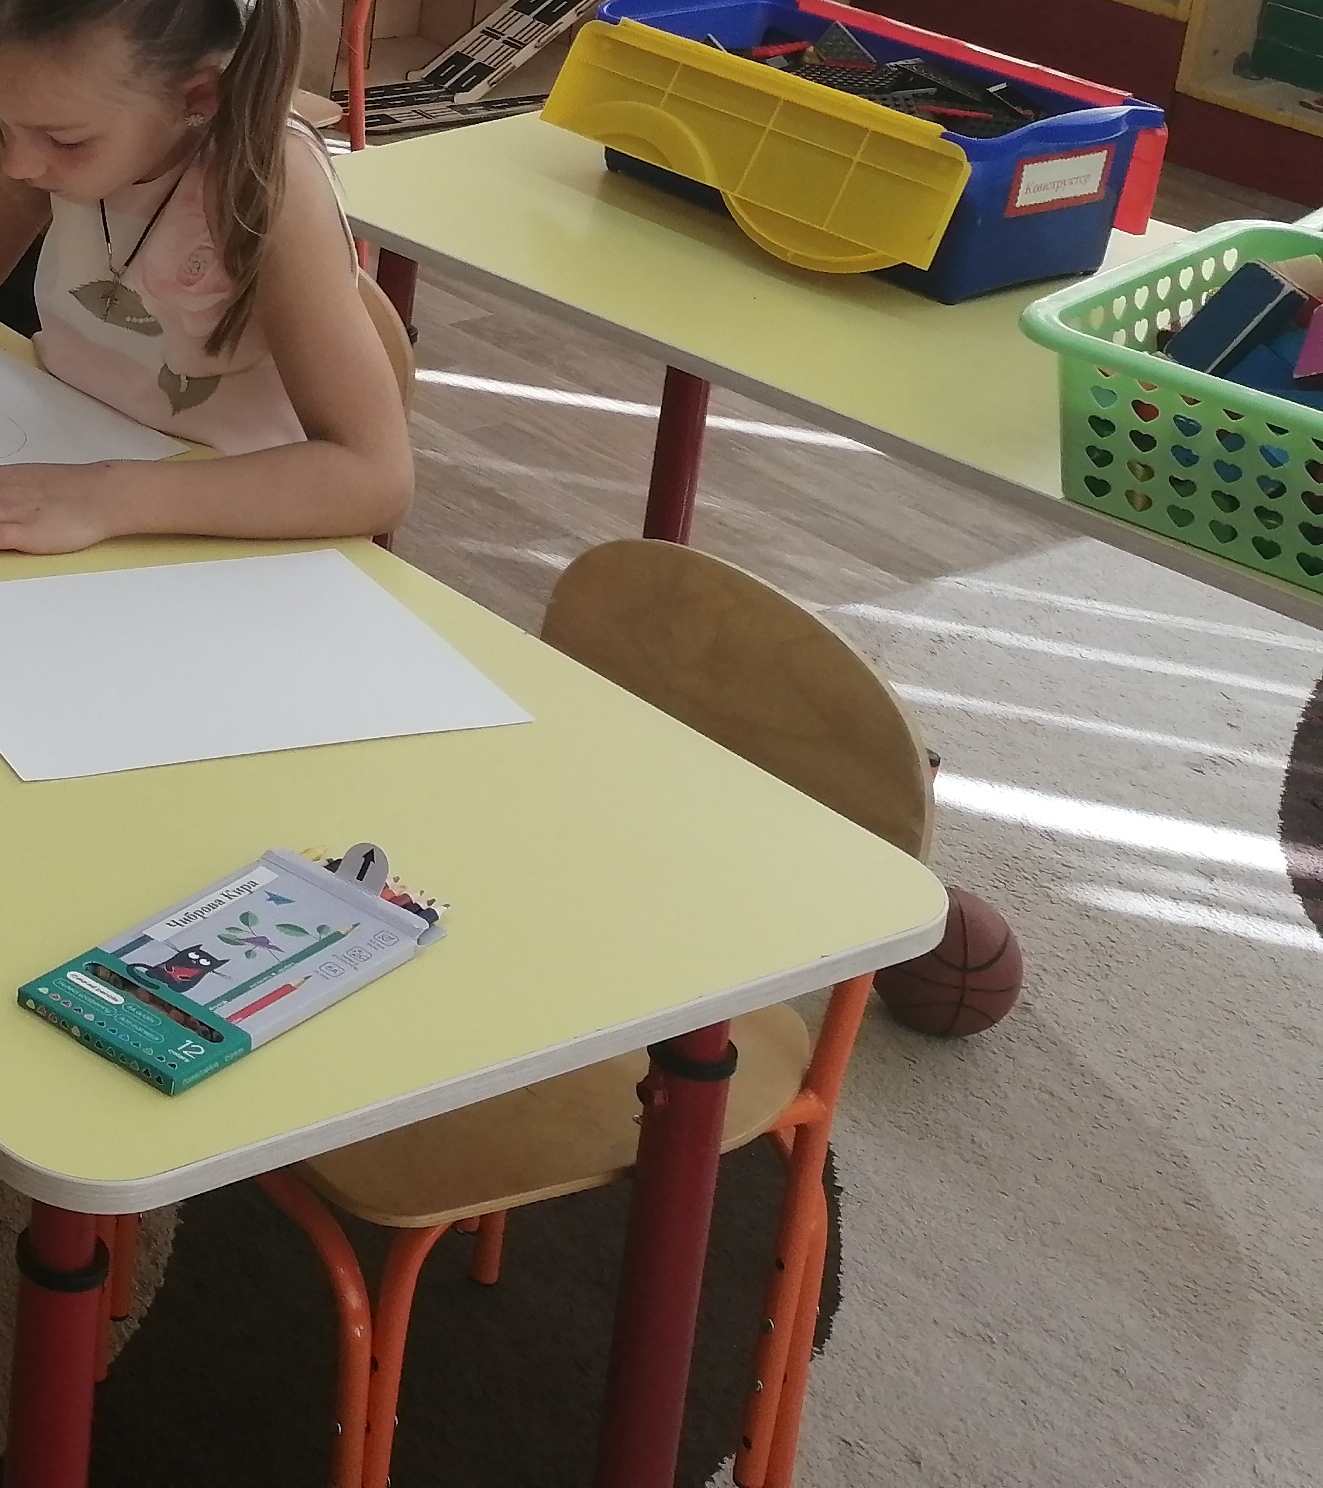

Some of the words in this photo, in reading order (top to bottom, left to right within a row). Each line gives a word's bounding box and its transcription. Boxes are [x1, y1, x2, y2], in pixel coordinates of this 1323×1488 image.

[1024, 174, 1092, 196] Конструктор
[166, 891, 226, 930] Чиброва
[220, 877, 260, 903] Кира
[177, 1040, 205, 1059] 12
